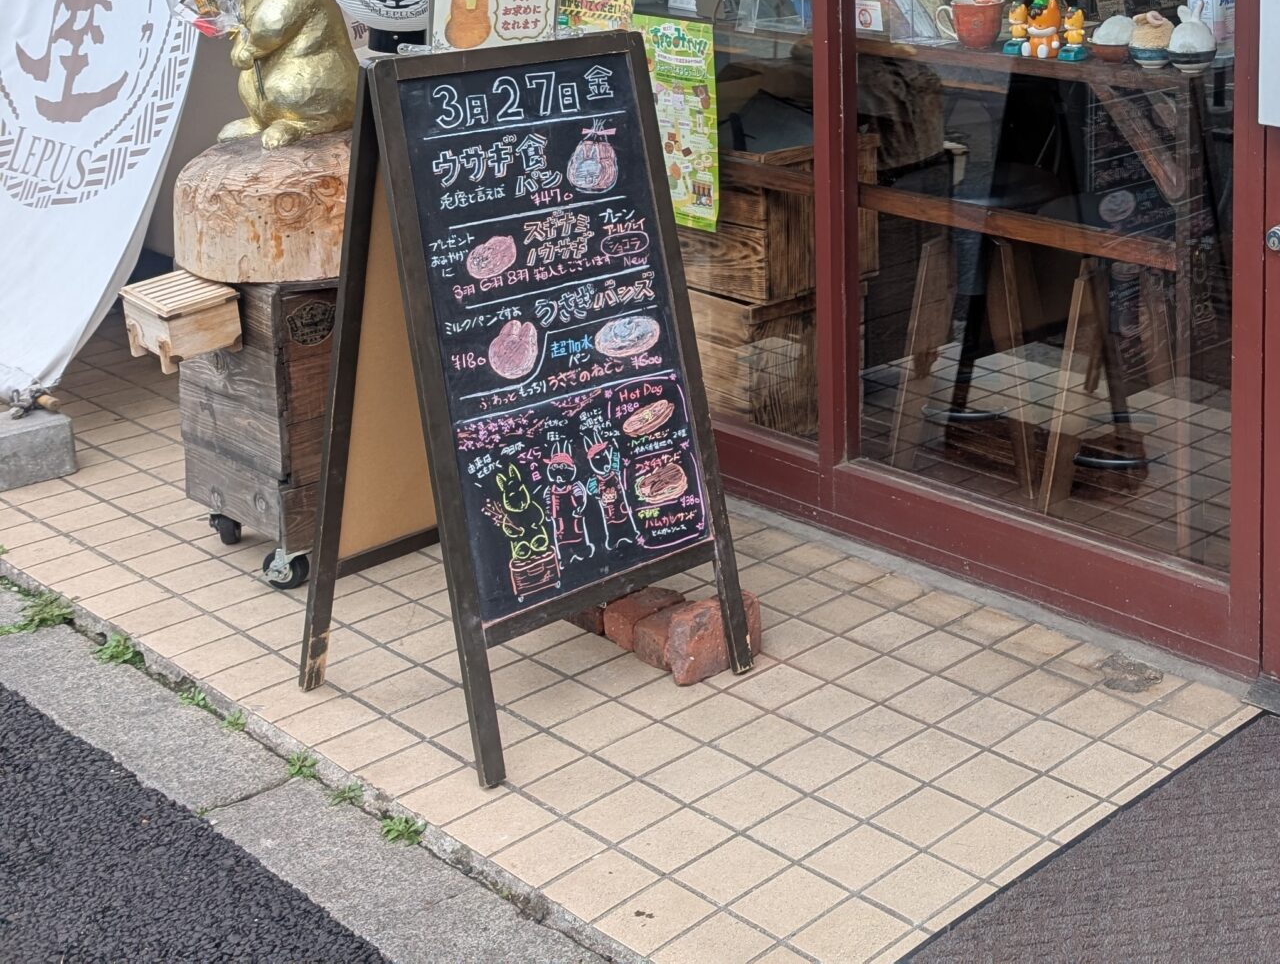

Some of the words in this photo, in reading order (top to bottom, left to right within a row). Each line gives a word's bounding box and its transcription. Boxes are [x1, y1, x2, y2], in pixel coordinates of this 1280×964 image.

[501, 5, 542, 17] お求めに
[501, 19, 541, 31] なれます
[431, 70, 582, 129] 3月27日
[583, 64, 615, 102] 金
[7, 125, 95, 191] LEPUS
[530, 187, 574, 208] ¥470
[598, 208, 636, 224] プレーン
[602, 217, 646, 236] アールグレイ
[428, 232, 475, 252] プレゼント
[606, 237, 642, 253] ショコラ
[430, 249, 469, 269] おみやげ
[623, 254, 649, 268] New
[441, 267, 456, 279] に
[550, 334, 594, 359] 超加水
[451, 352, 487, 371] ¥180
[568, 350, 591, 367] パン
[548, 357, 625, 392] うさぎのねどこ
[618, 387, 641, 403] Hot
[643, 383, 664, 399] Dog
[517, 446, 542, 465] さくら
